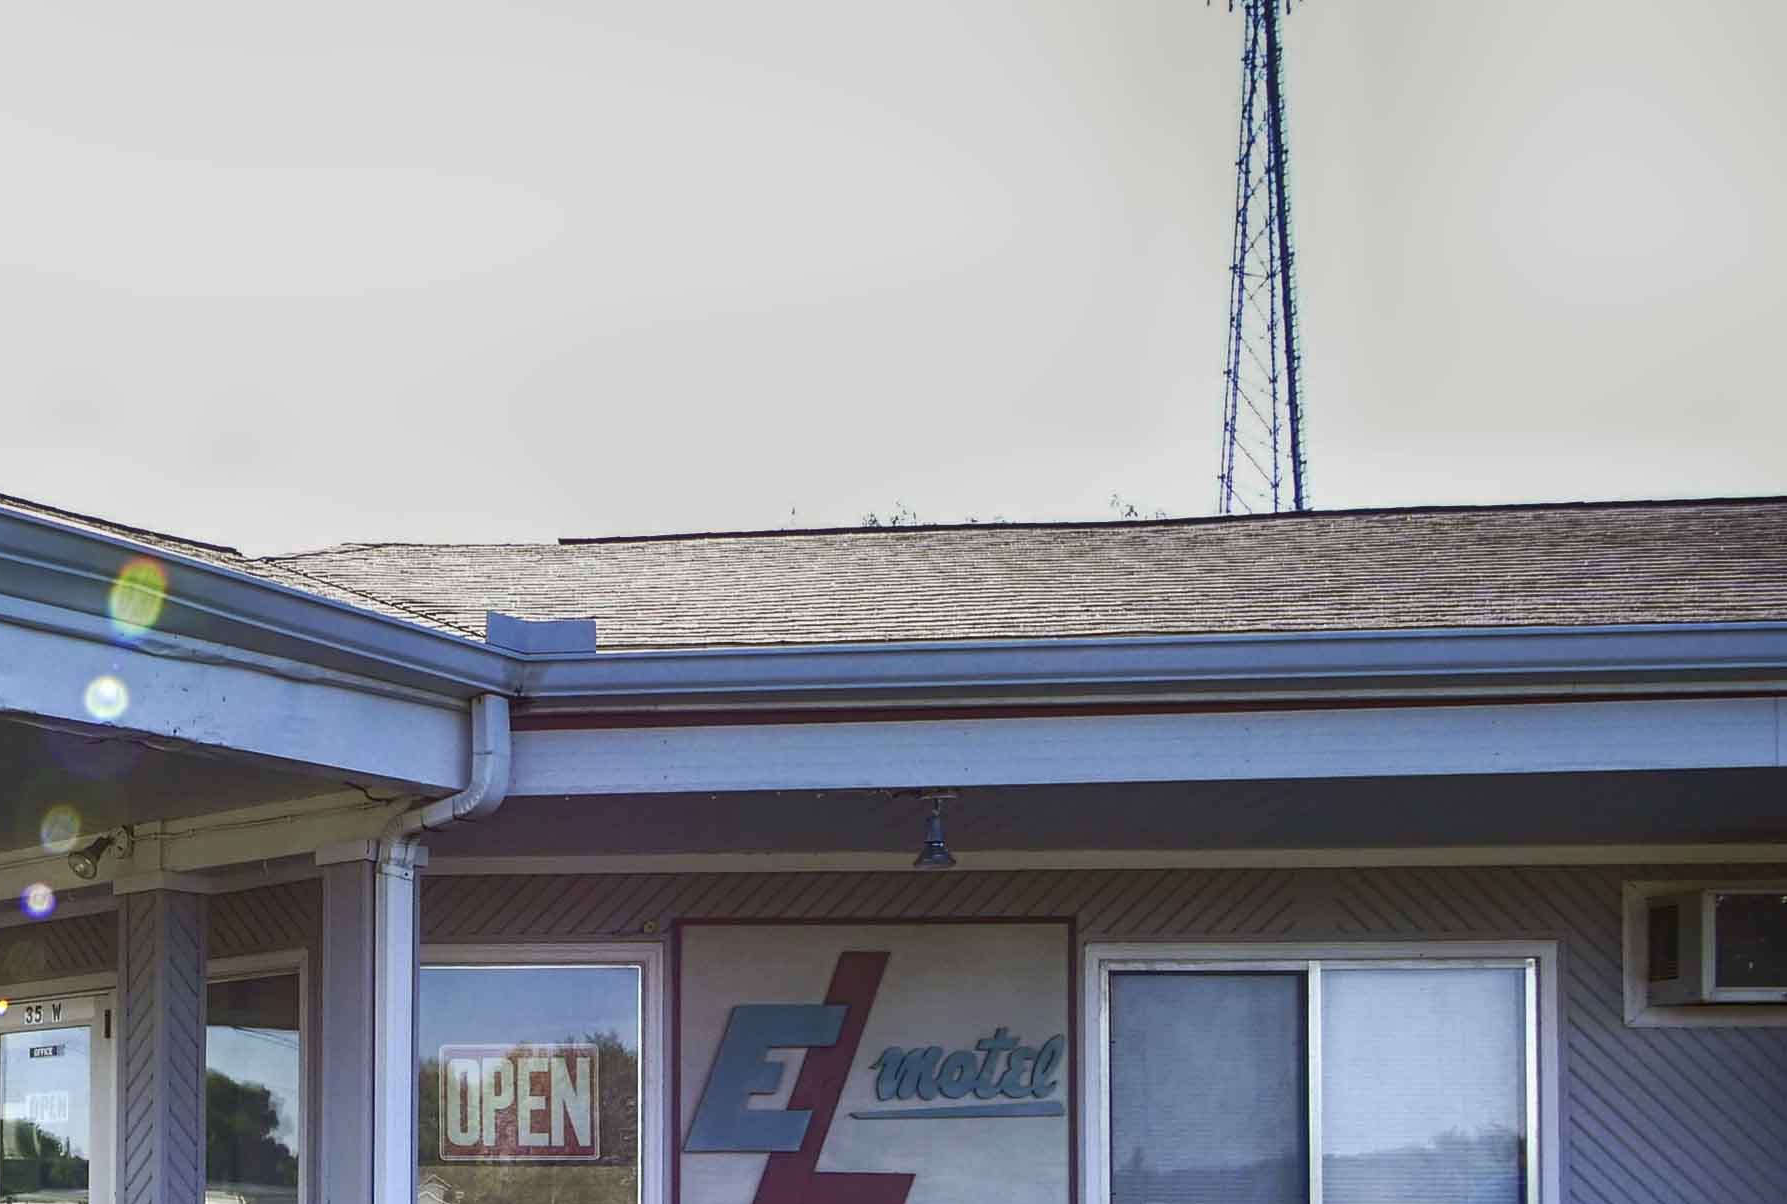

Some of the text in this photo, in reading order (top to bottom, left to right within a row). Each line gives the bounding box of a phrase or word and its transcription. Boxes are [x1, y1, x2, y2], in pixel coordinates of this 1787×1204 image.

[25, 1002, 62, 1024] 35 W
[447, 1056, 591, 1147] OPEN
